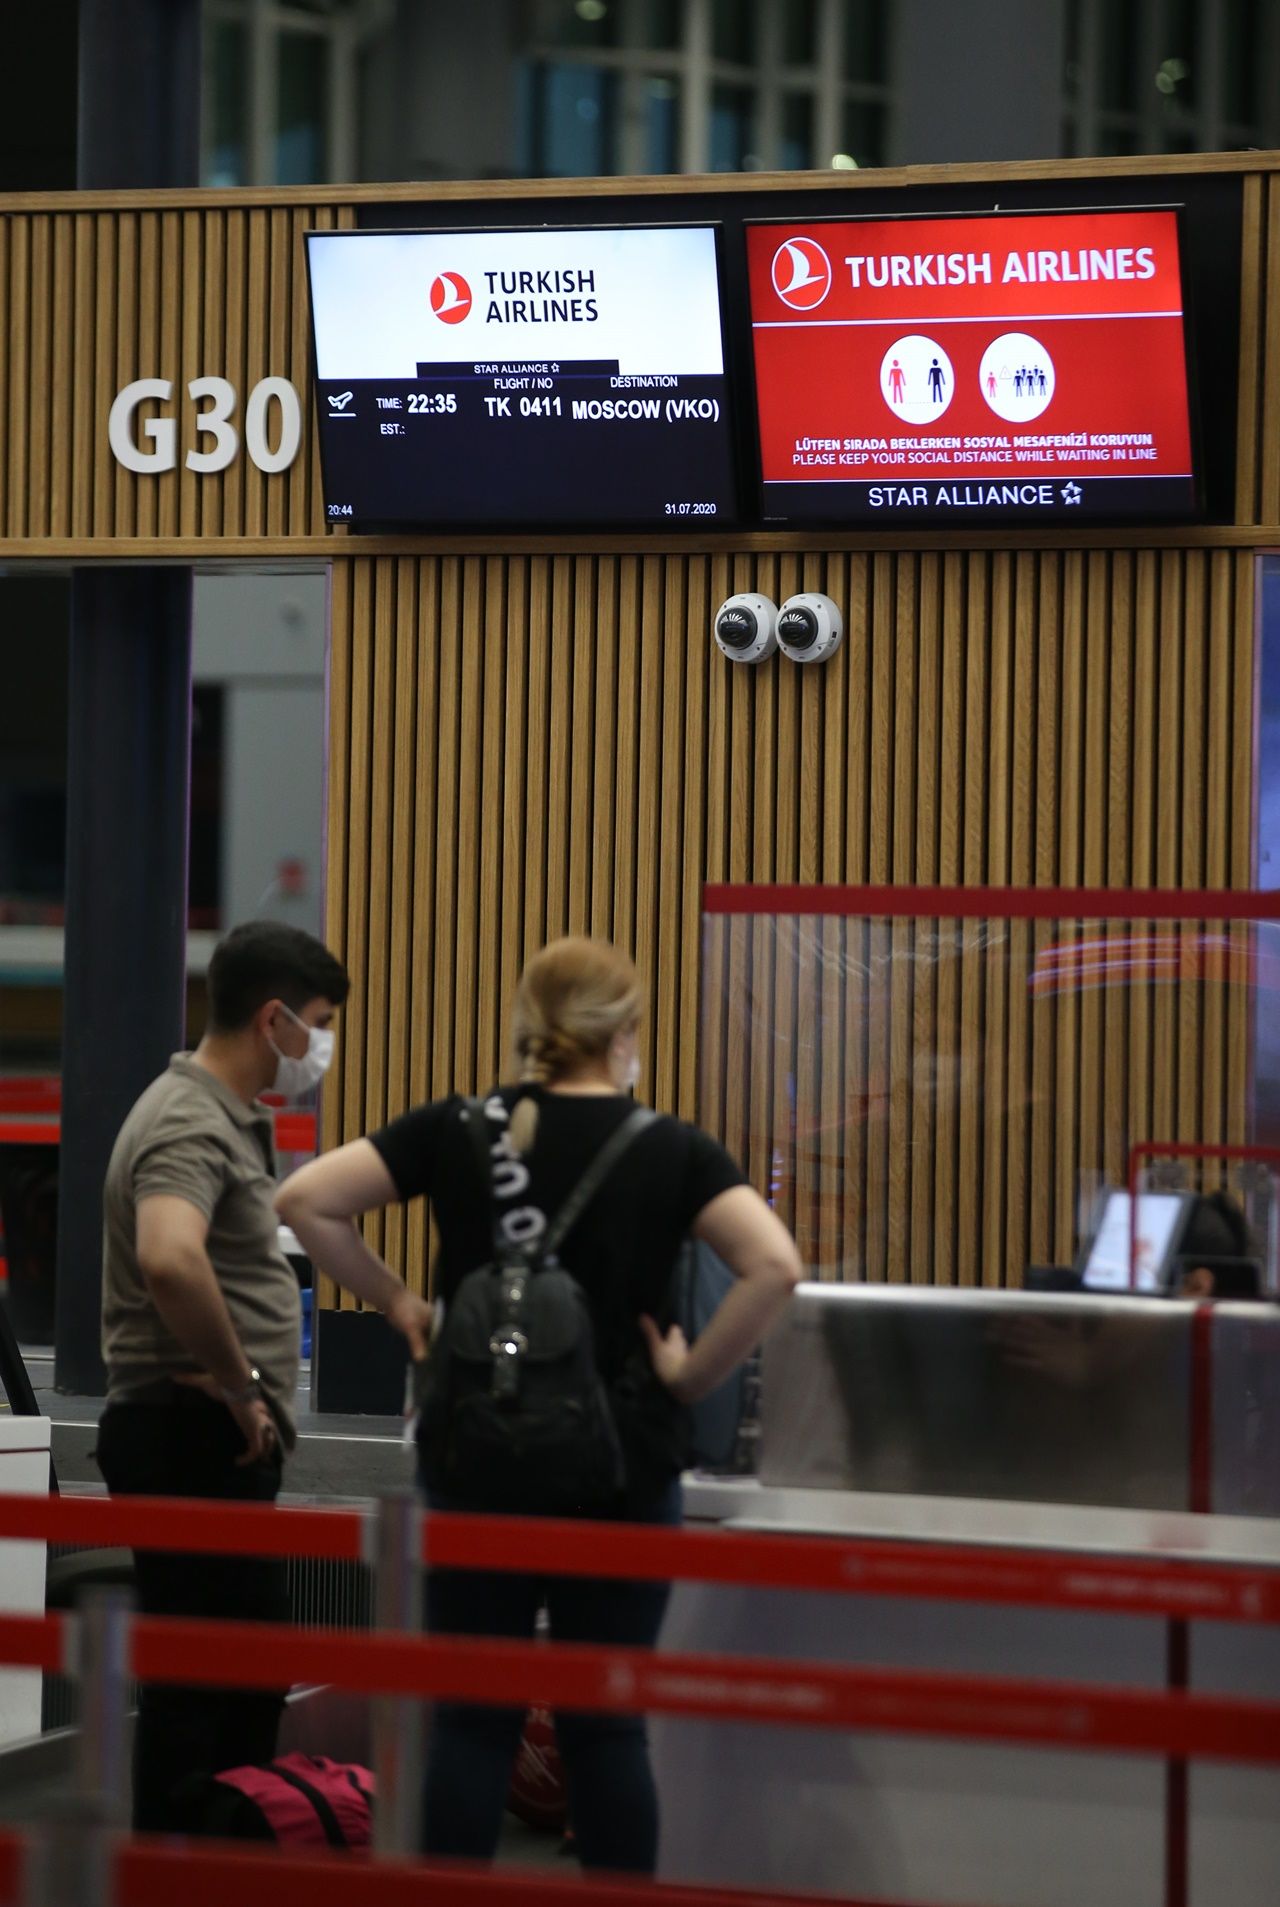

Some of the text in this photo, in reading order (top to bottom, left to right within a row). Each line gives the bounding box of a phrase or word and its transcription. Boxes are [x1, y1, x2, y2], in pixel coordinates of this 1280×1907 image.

[844, 247, 1156, 288] TURKISH AIRLINES
[484, 269, 595, 294] TURKISH
[486, 298, 599, 323] AIRLINES
[474, 363, 549, 374] STAR ALLIANCE
[494, 377, 532, 389] FLIGHT
[537, 377, 553, 389] NO
[610, 376, 678, 388] DESTINATION
[376, 393, 458, 413] TIME: 22:35
[484, 396, 562, 417] TK 0411
[572, 399, 720, 423] MOSCOW (VKO)
[108, 376, 301, 474] G30
[795, 432, 1153, 451] LÜTFEN SIRADA BEKLERKEN SOSYAL MESAFENİZİ KORUYUN
[792, 448, 1158, 465] PLEASE KEEP YOUR SOCIAL DISTANCE WHILE WAITING IN LINE
[868, 485, 1054, 507] STAR ALLIANCE
[328, 504, 353, 516] 20:44
[664, 503, 717, 515] 31.07.2020
